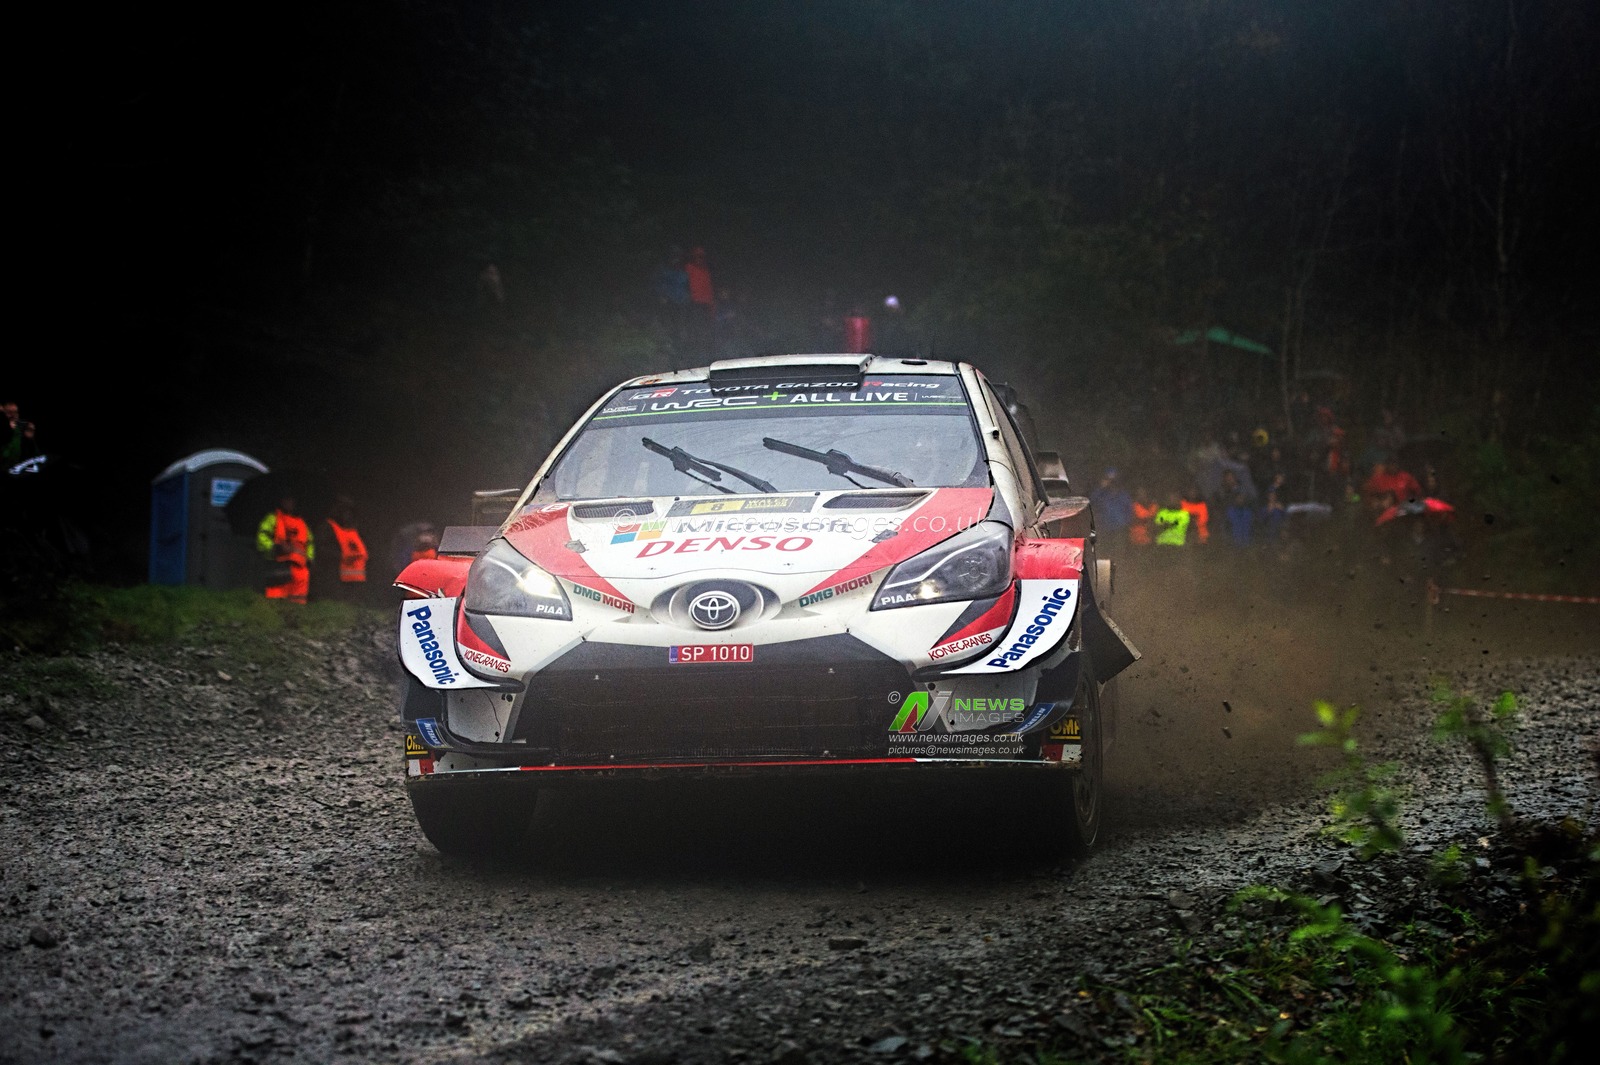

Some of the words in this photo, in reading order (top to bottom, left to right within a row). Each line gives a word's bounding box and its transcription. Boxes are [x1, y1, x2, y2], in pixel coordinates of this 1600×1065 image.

[681, 385, 769, 395] TOYOTA
[776, 381, 858, 389] GAZOO
[863, 381, 940, 389] Racing
[790, 393, 841, 403] ALL
[850, 392, 909, 402] LIVE
[676, 519, 853, 534] Microsoft
[636, 536, 813, 559] DENSO
[573, 584, 601, 602] DMG
[602, 594, 635, 614] MORI
[800, 587, 833, 607] DMG
[835, 574, 873, 596] MORI
[881, 594, 915, 606] PIAA
[536, 604, 563, 615] PIAA
[987, 587, 1072, 669] Panasonic
[407, 605, 460, 685] Panasonic
[681, 647, 704, 661] SP
[711, 646, 749, 660] 1010
[928, 633, 993, 661] KONECRANES
